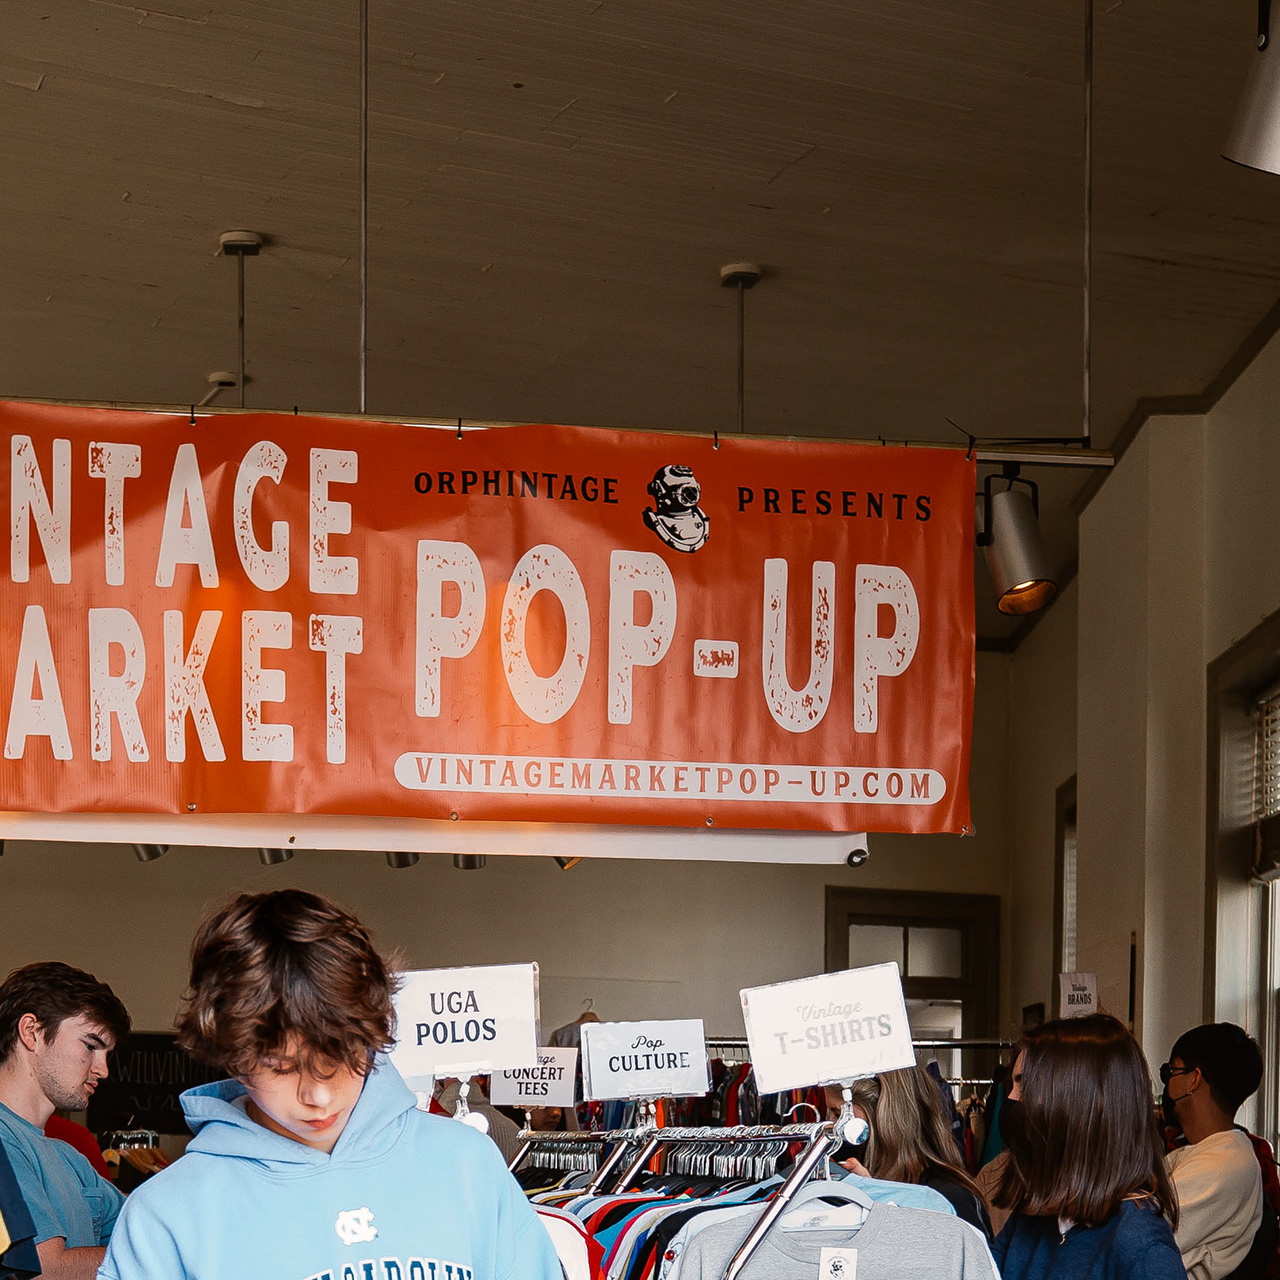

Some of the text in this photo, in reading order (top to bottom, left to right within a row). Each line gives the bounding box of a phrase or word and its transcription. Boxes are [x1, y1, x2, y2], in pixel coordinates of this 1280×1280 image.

[414, 470, 932, 521] ORPHINTAGE PRESENTS
[415, 539, 920, 734] POP-UP
[415, 757, 930, 799] VINTAGEMARKETPOP-UP.COM
[430, 990, 480, 1015] UGA
[797, 1000, 863, 1021] Vintage
[1067, 994, 1092, 1005] BRANDS
[416, 1018, 497, 1046] POLOS
[631, 1035, 665, 1051] Pop
[774, 1014, 892, 1055] T-SHIRTS
[504, 1067, 565, 1080] CONCERT
[608, 1052, 690, 1072] CULTURE
[517, 1082, 549, 1095] TEES
